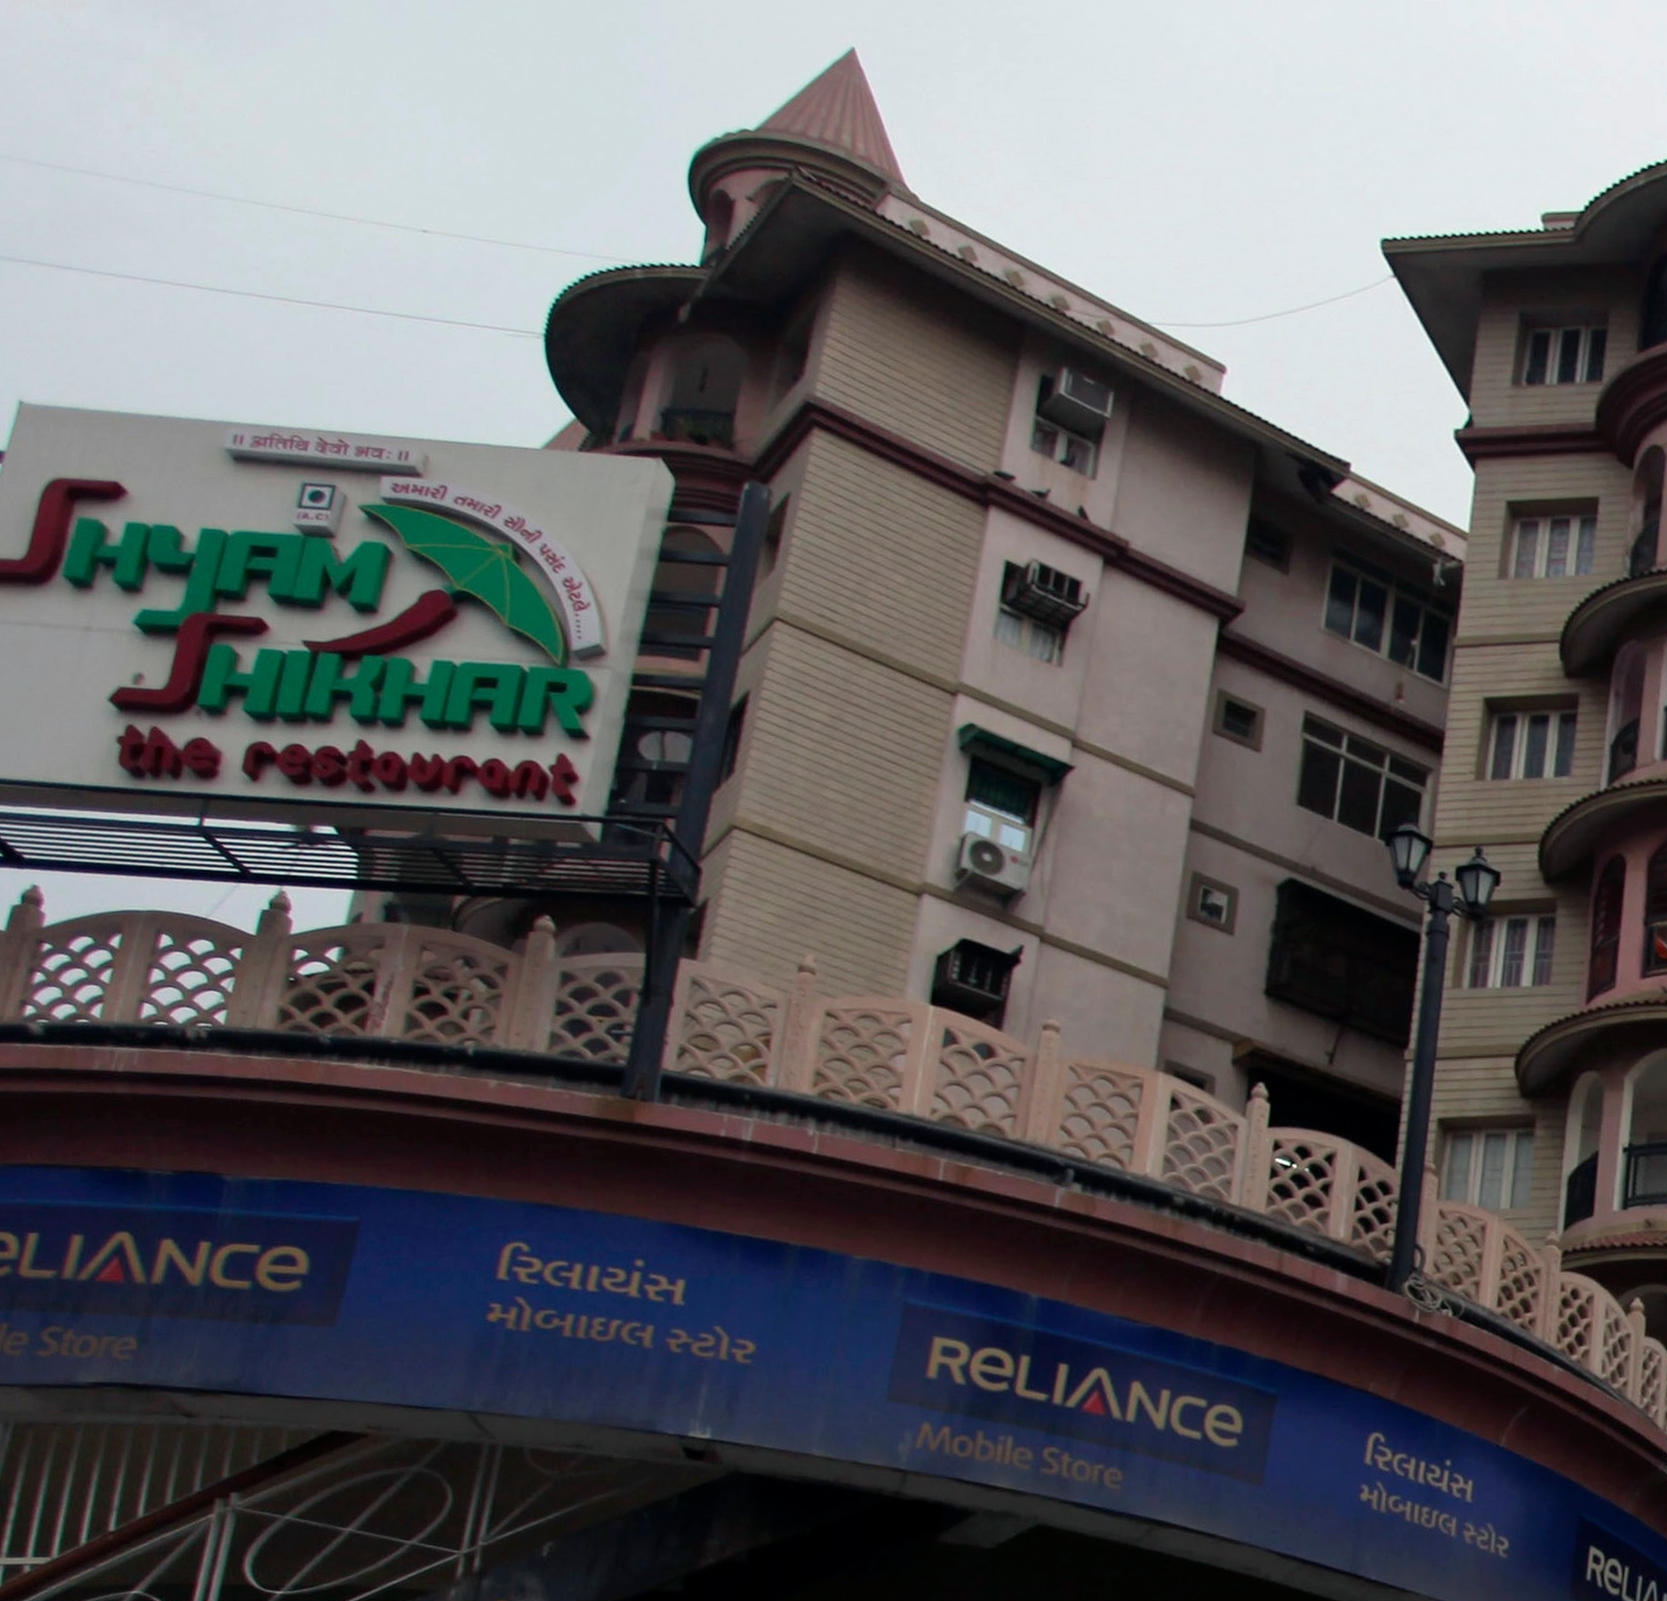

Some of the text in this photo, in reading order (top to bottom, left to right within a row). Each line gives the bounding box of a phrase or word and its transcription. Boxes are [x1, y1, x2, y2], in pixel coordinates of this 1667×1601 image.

[250, 434, 309, 451] अतिथि
[315, 437, 350, 456] देवो
[390, 482, 448, 500] અમારી
[453, 494, 502, 519] તમારી
[0, 478, 393, 635] SHYAM
[109, 612, 594, 738] SHIKHAR
[118, 725, 579, 807] the restaurant
[495, 1240, 687, 1307] રિલાયંસ
[38, 1326, 137, 1361] Store
[665, 1325, 757, 1365] સ્ટોર
[914, 1421, 1123, 1493] Mobile Store
[1363, 1431, 1474, 1504] રિલાયંસ
[1462, 1515, 1510, 1561] સ્ટોર
